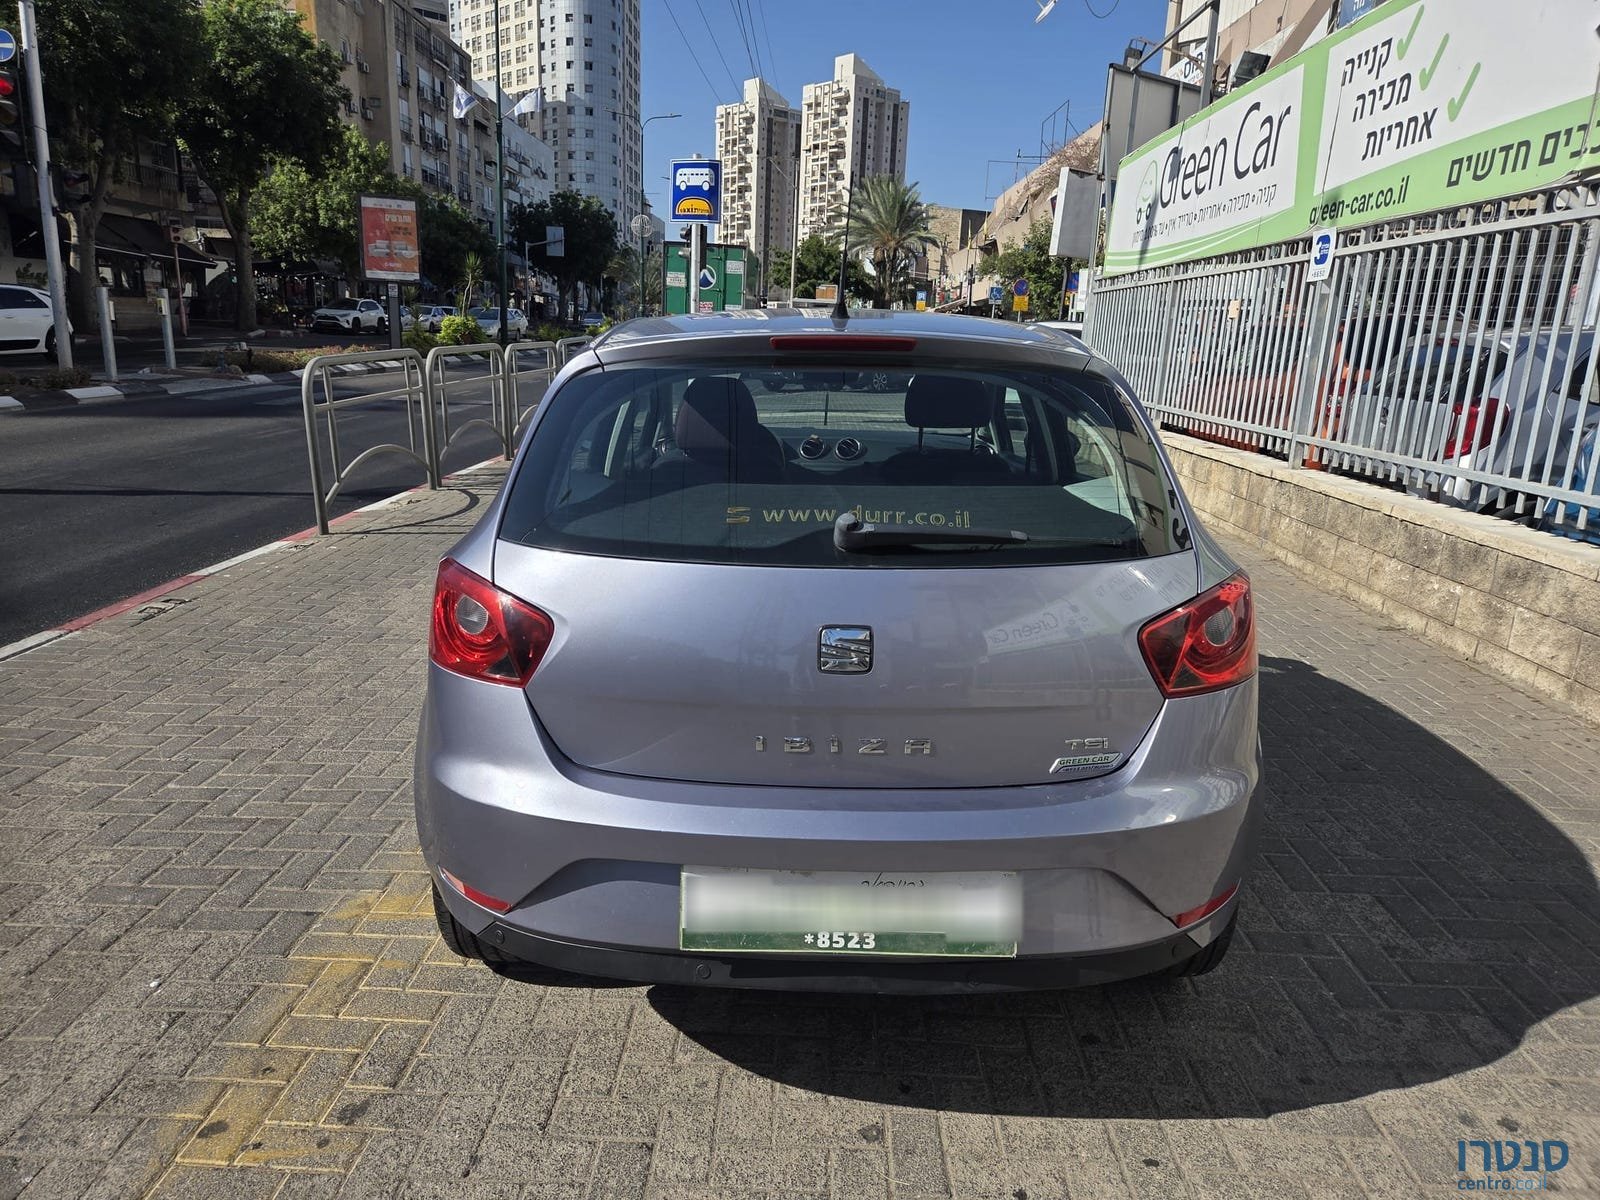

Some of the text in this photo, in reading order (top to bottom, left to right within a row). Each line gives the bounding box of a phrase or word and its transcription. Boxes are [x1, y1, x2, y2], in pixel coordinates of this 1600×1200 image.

[1341, 37, 1393, 87] קנייה
[1352, 73, 1411, 122] מכירה
[1361, 107, 1438, 161] אחריות
[1160, 102, 1292, 208] Green Car
[1446, 139, 1532, 188] חדשים
[1227, 193, 1250, 214] מכירה
[1256, 184, 1278, 206] קניה
[763, 505, 970, 528] wwwdurr.co.il
[1059, 755, 1110, 765] GREEN CAR
[1065, 737, 1109, 750] TSI
